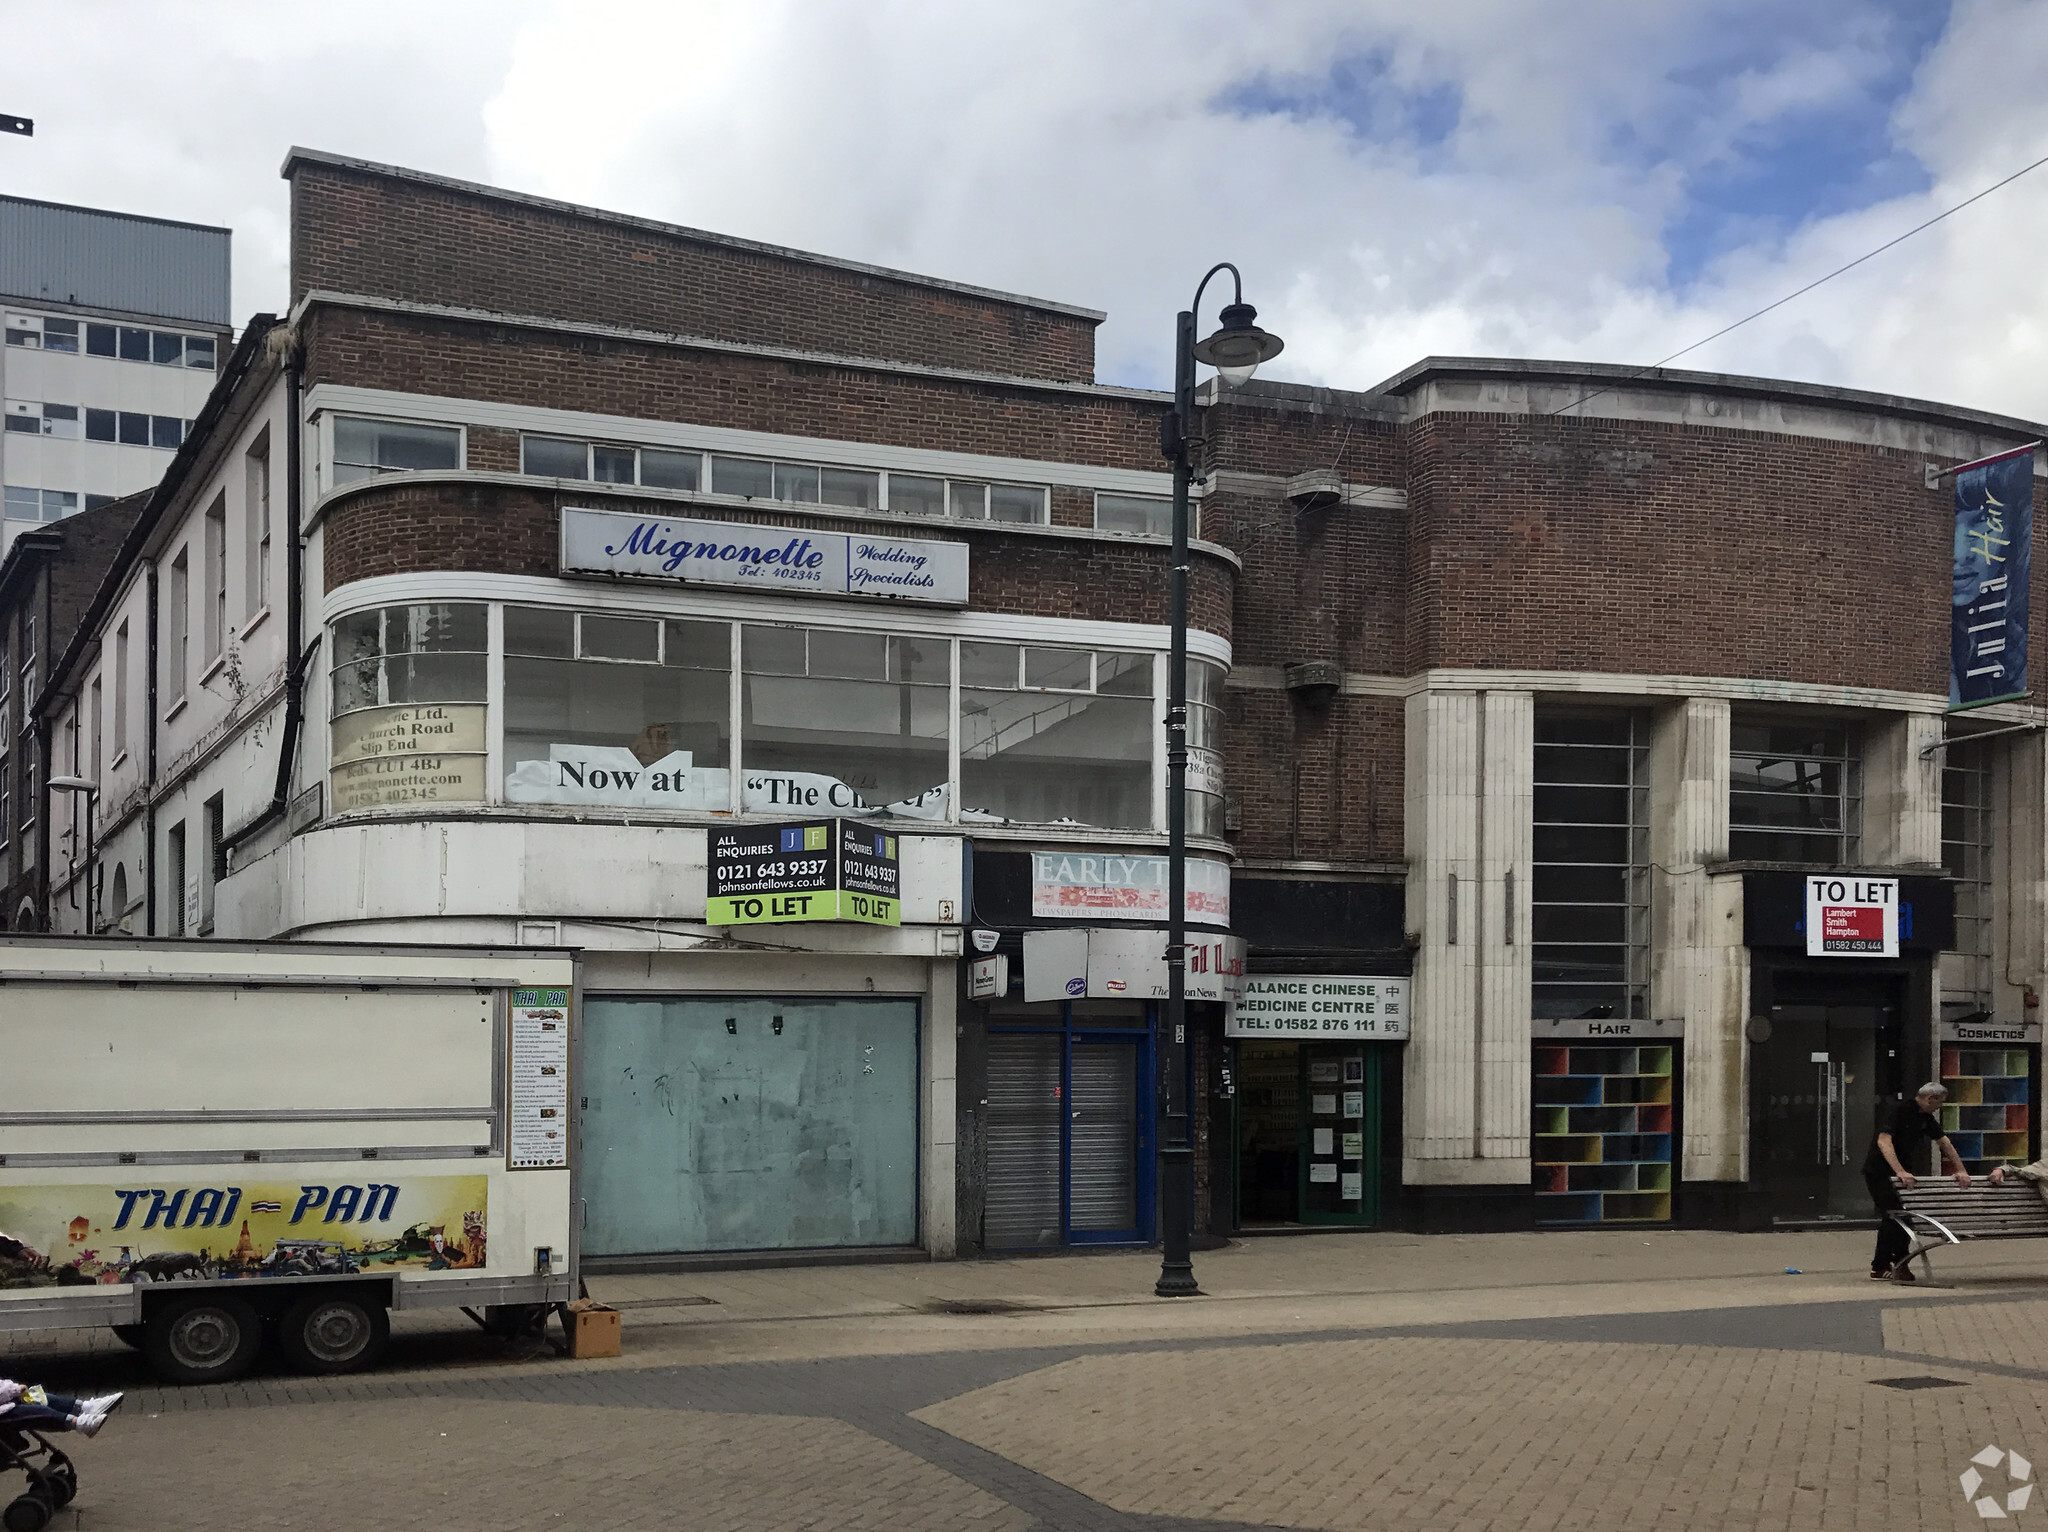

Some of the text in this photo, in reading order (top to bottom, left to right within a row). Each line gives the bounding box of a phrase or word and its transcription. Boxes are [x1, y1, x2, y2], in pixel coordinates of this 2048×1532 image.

[604, 522, 824, 572] Mignonette
[856, 544, 928, 571] Wedding
[738, 564, 821, 581] Tel: 402345
[849, 567, 935, 588] Specialists
[1966, 487, 2011, 679] Julia Hair
[415, 707, 448, 721] Ltd.
[411, 722, 454, 735] Road
[388, 738, 417, 751] End
[376, 759, 405, 774] LU1
[410, 759, 442, 771] 4BJ
[556, 760, 641, 790] Now
[650, 767, 686, 792] at
[748, 777, 819, 806] “The
[384, 787, 438, 802] 402345
[717, 835, 737, 847] ALL
[788, 830, 820, 849] J F
[844, 830, 855, 841] ALL
[716, 844, 774, 858] ENQUIRIES
[844, 840, 873, 856] ENQUIRIES
[717, 859, 828, 880] 0121 643 9337
[844, 859, 897, 883] 0121 643 9337
[1036, 855, 1141, 886] EARLY
[718, 875, 826, 895] johnsonfellows.co.uk
[845, 876, 896, 895] johnsonfellows.co.uk
[1812, 880, 1894, 904] TO LET
[729, 896, 813, 919] TO LET
[851, 896, 891, 920] TO LET
[1035, 907, 1092, 917] NEWSPAPERS
[1826, 908, 1857, 917] Lambert
[1826, 917, 1848, 926] Smith
[1826, 926, 1860, 937] Hampton
[1826, 940, 1882, 950] 01582 450 444
[1151, 985, 1169, 996] The
[1197, 987, 1217, 998] News
[1247, 982, 1308, 995] ALANCE
[1312, 983, 1376, 996] CHINESE
[513, 990, 567, 1006] THAI PAN
[1236, 1000, 1375, 1014] MEDICINE CENTRE
[1236, 1017, 1375, 1031] TEL: 01582 876 111
[111, 1183, 402, 1231] THAI PAN
